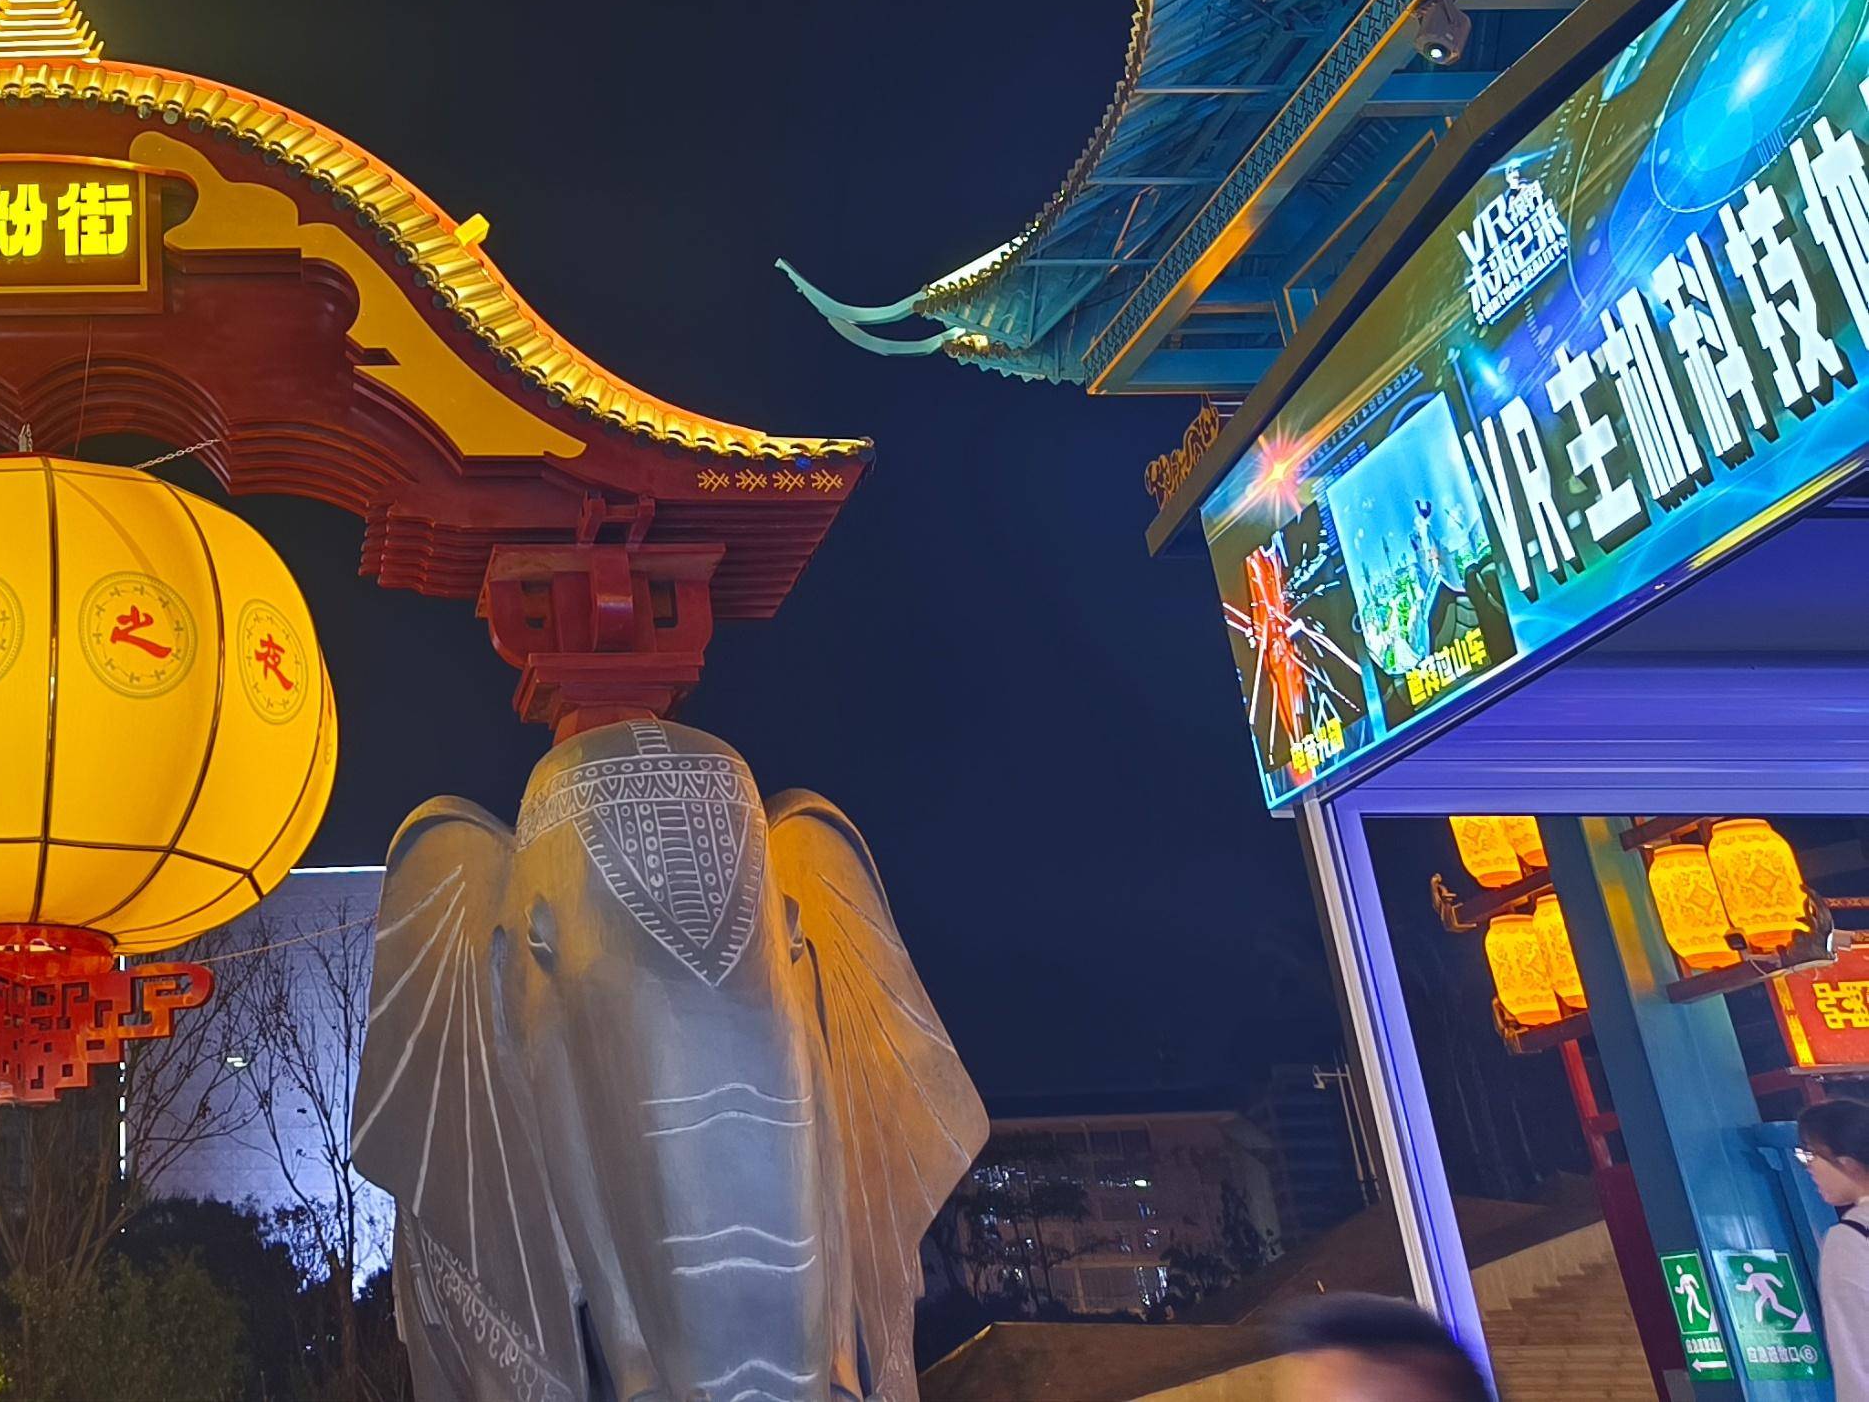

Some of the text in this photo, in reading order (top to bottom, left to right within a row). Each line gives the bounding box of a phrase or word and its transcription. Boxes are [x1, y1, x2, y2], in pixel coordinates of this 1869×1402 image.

[1456, 194, 1512, 265] VR
[1463, 79, 1869, 592] VR主机科技体
